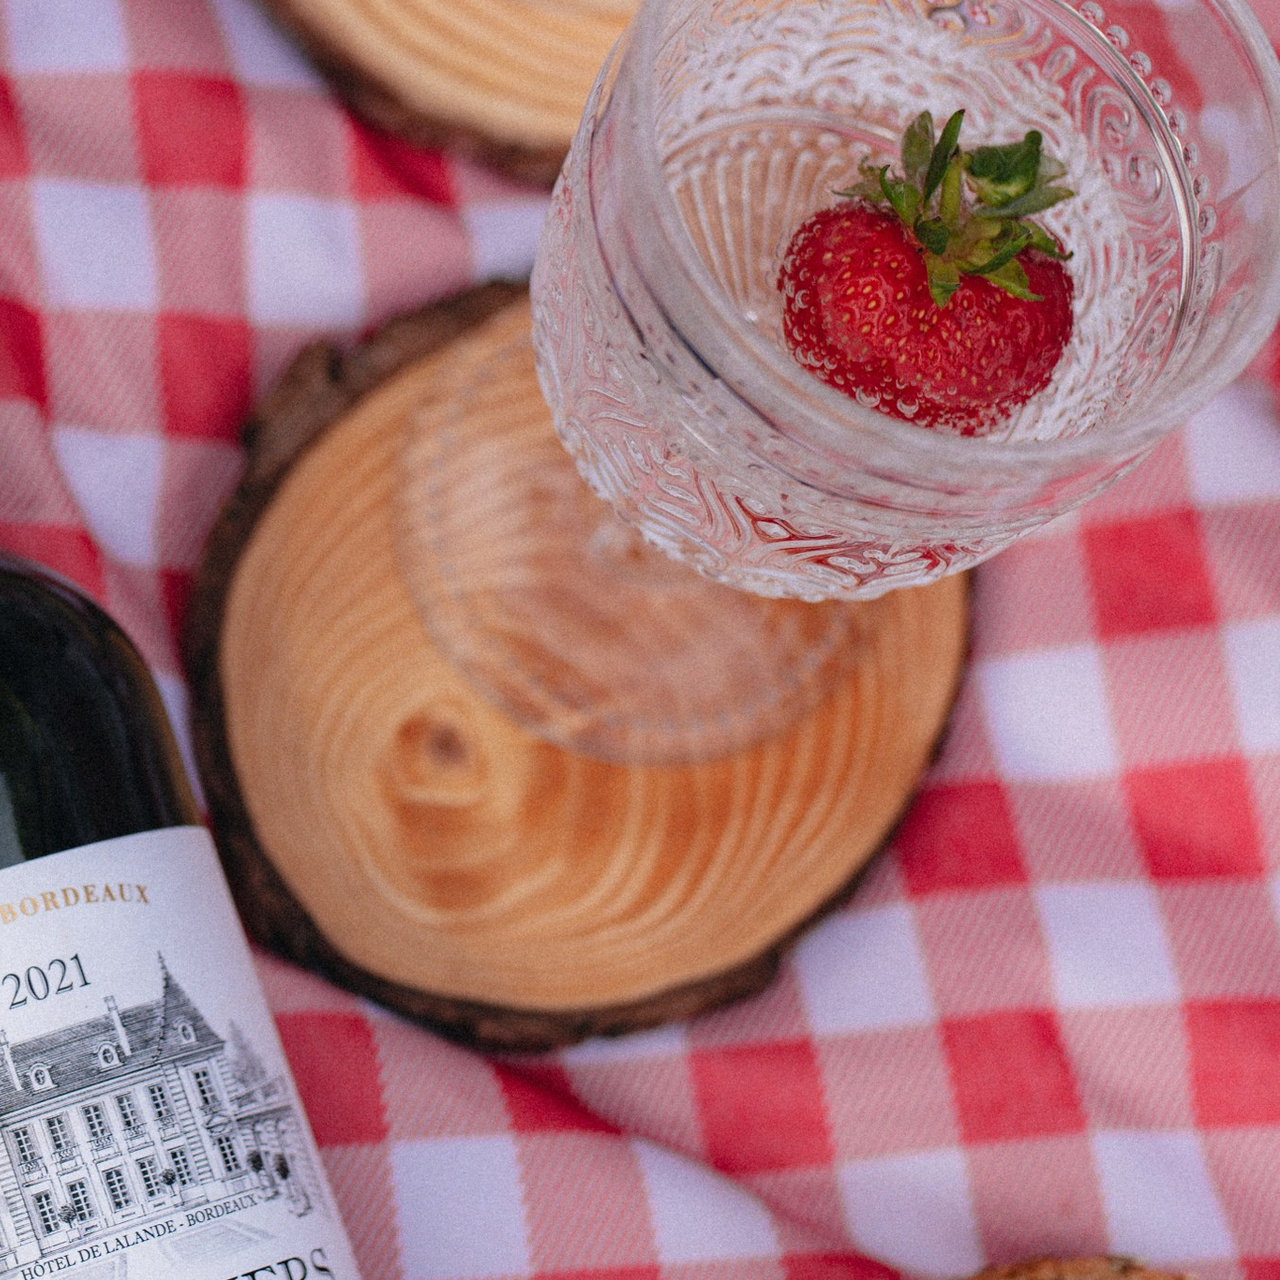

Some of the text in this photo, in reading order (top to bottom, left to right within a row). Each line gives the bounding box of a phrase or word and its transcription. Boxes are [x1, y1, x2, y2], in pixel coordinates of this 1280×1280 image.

[1, 953, 92, 1010] 2021
[77, 1243, 102, 1264] DE
[105, 1218, 177, 1254] LALANDE
[185, 1192, 259, 1227] BORDEAUX
